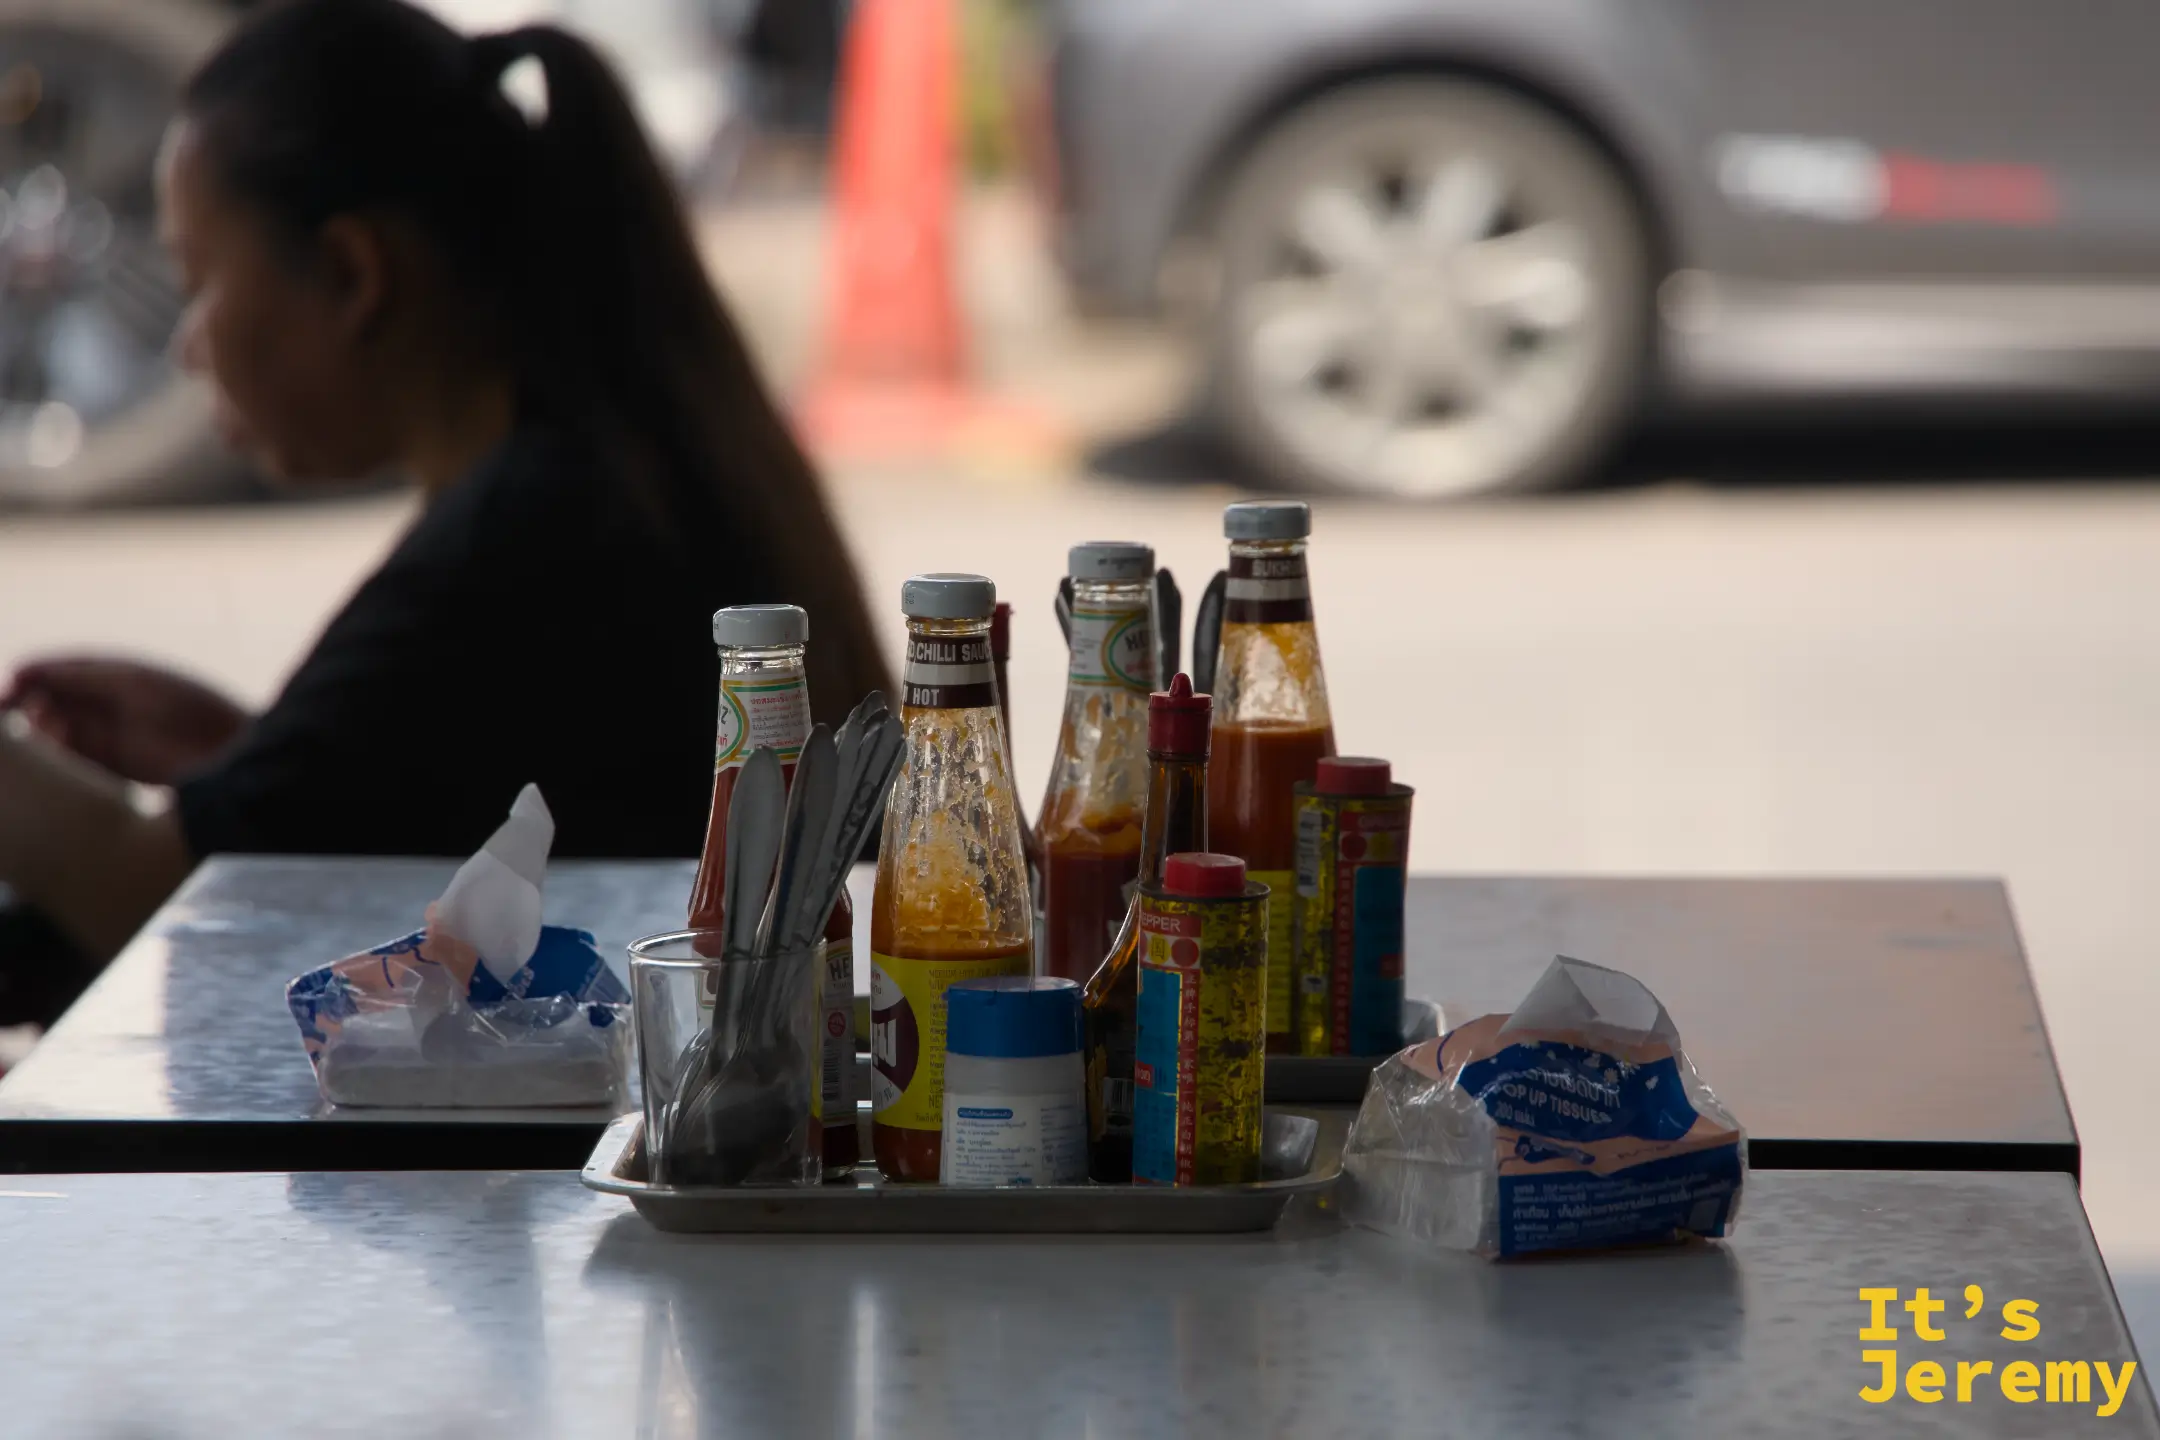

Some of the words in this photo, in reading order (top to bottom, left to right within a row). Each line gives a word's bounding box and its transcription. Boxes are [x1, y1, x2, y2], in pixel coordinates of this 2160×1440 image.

[916, 643, 956, 662] CHILLI
[913, 687, 940, 706] HOT
[1528, 1087, 1548, 1108] UP
